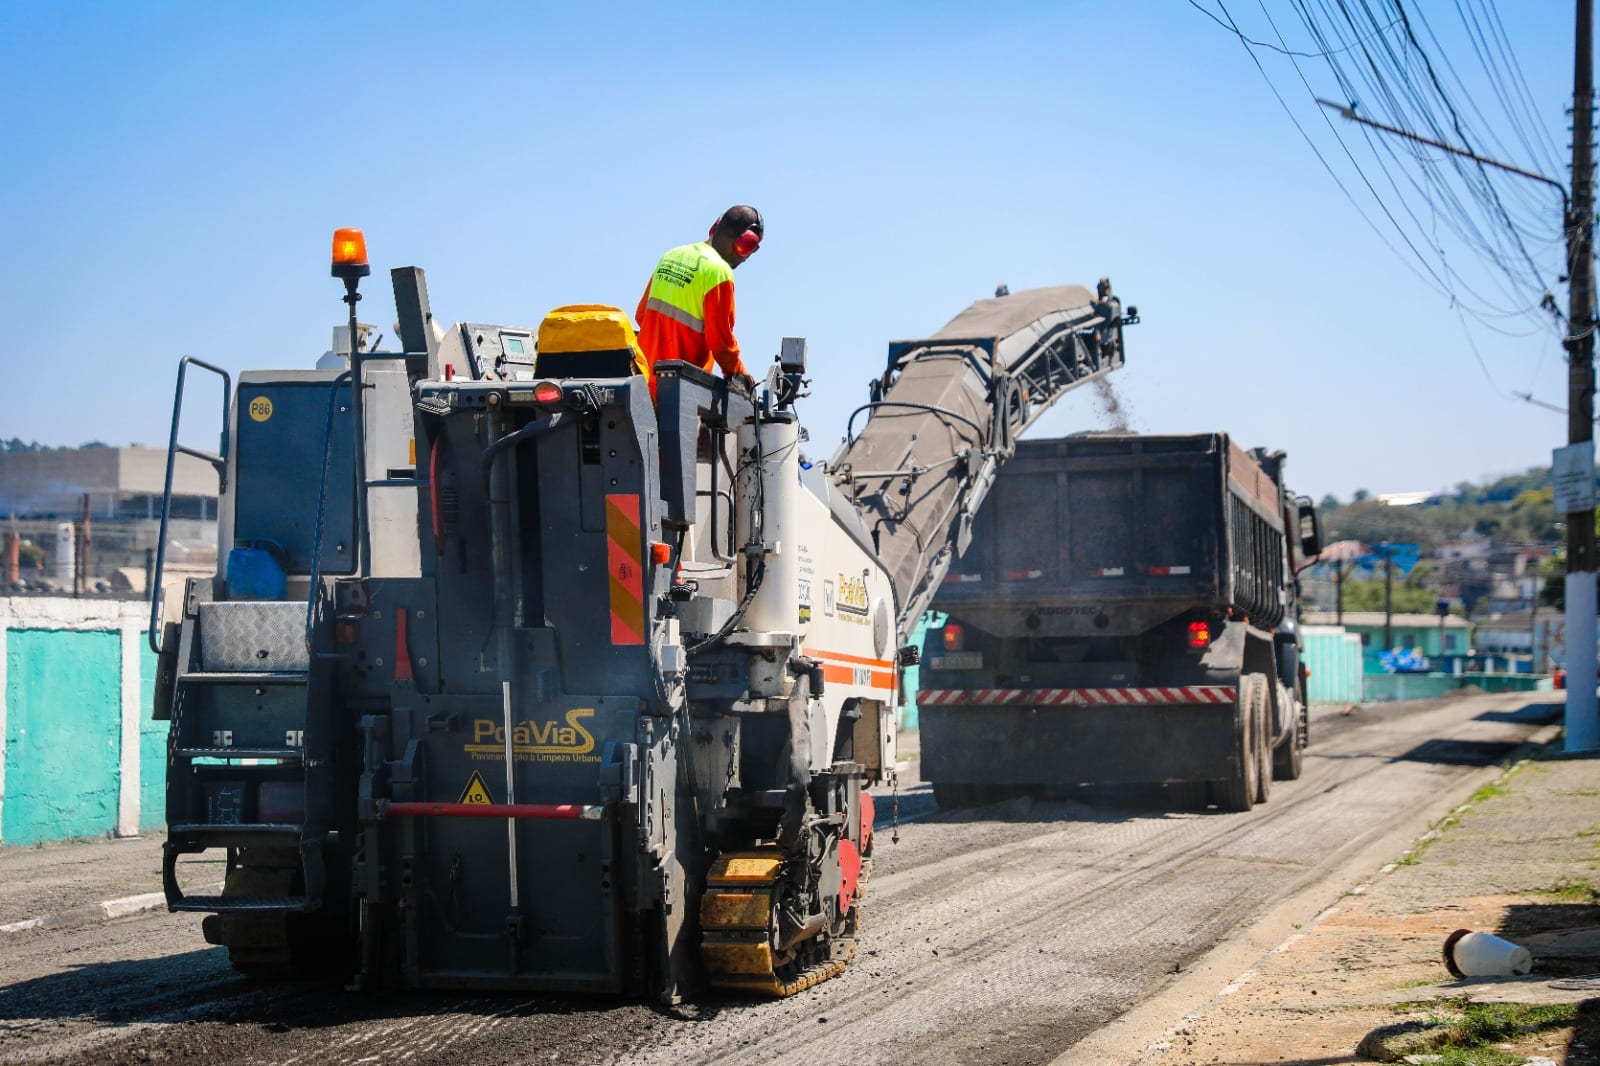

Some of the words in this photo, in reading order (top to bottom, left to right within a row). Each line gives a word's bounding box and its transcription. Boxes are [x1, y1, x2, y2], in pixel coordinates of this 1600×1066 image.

[251, 402, 271, 416] P86
[471, 751, 528, 762] Pavimenção
[536, 752, 571, 763] Limpeza
[572, 753, 602, 763] Urbana
